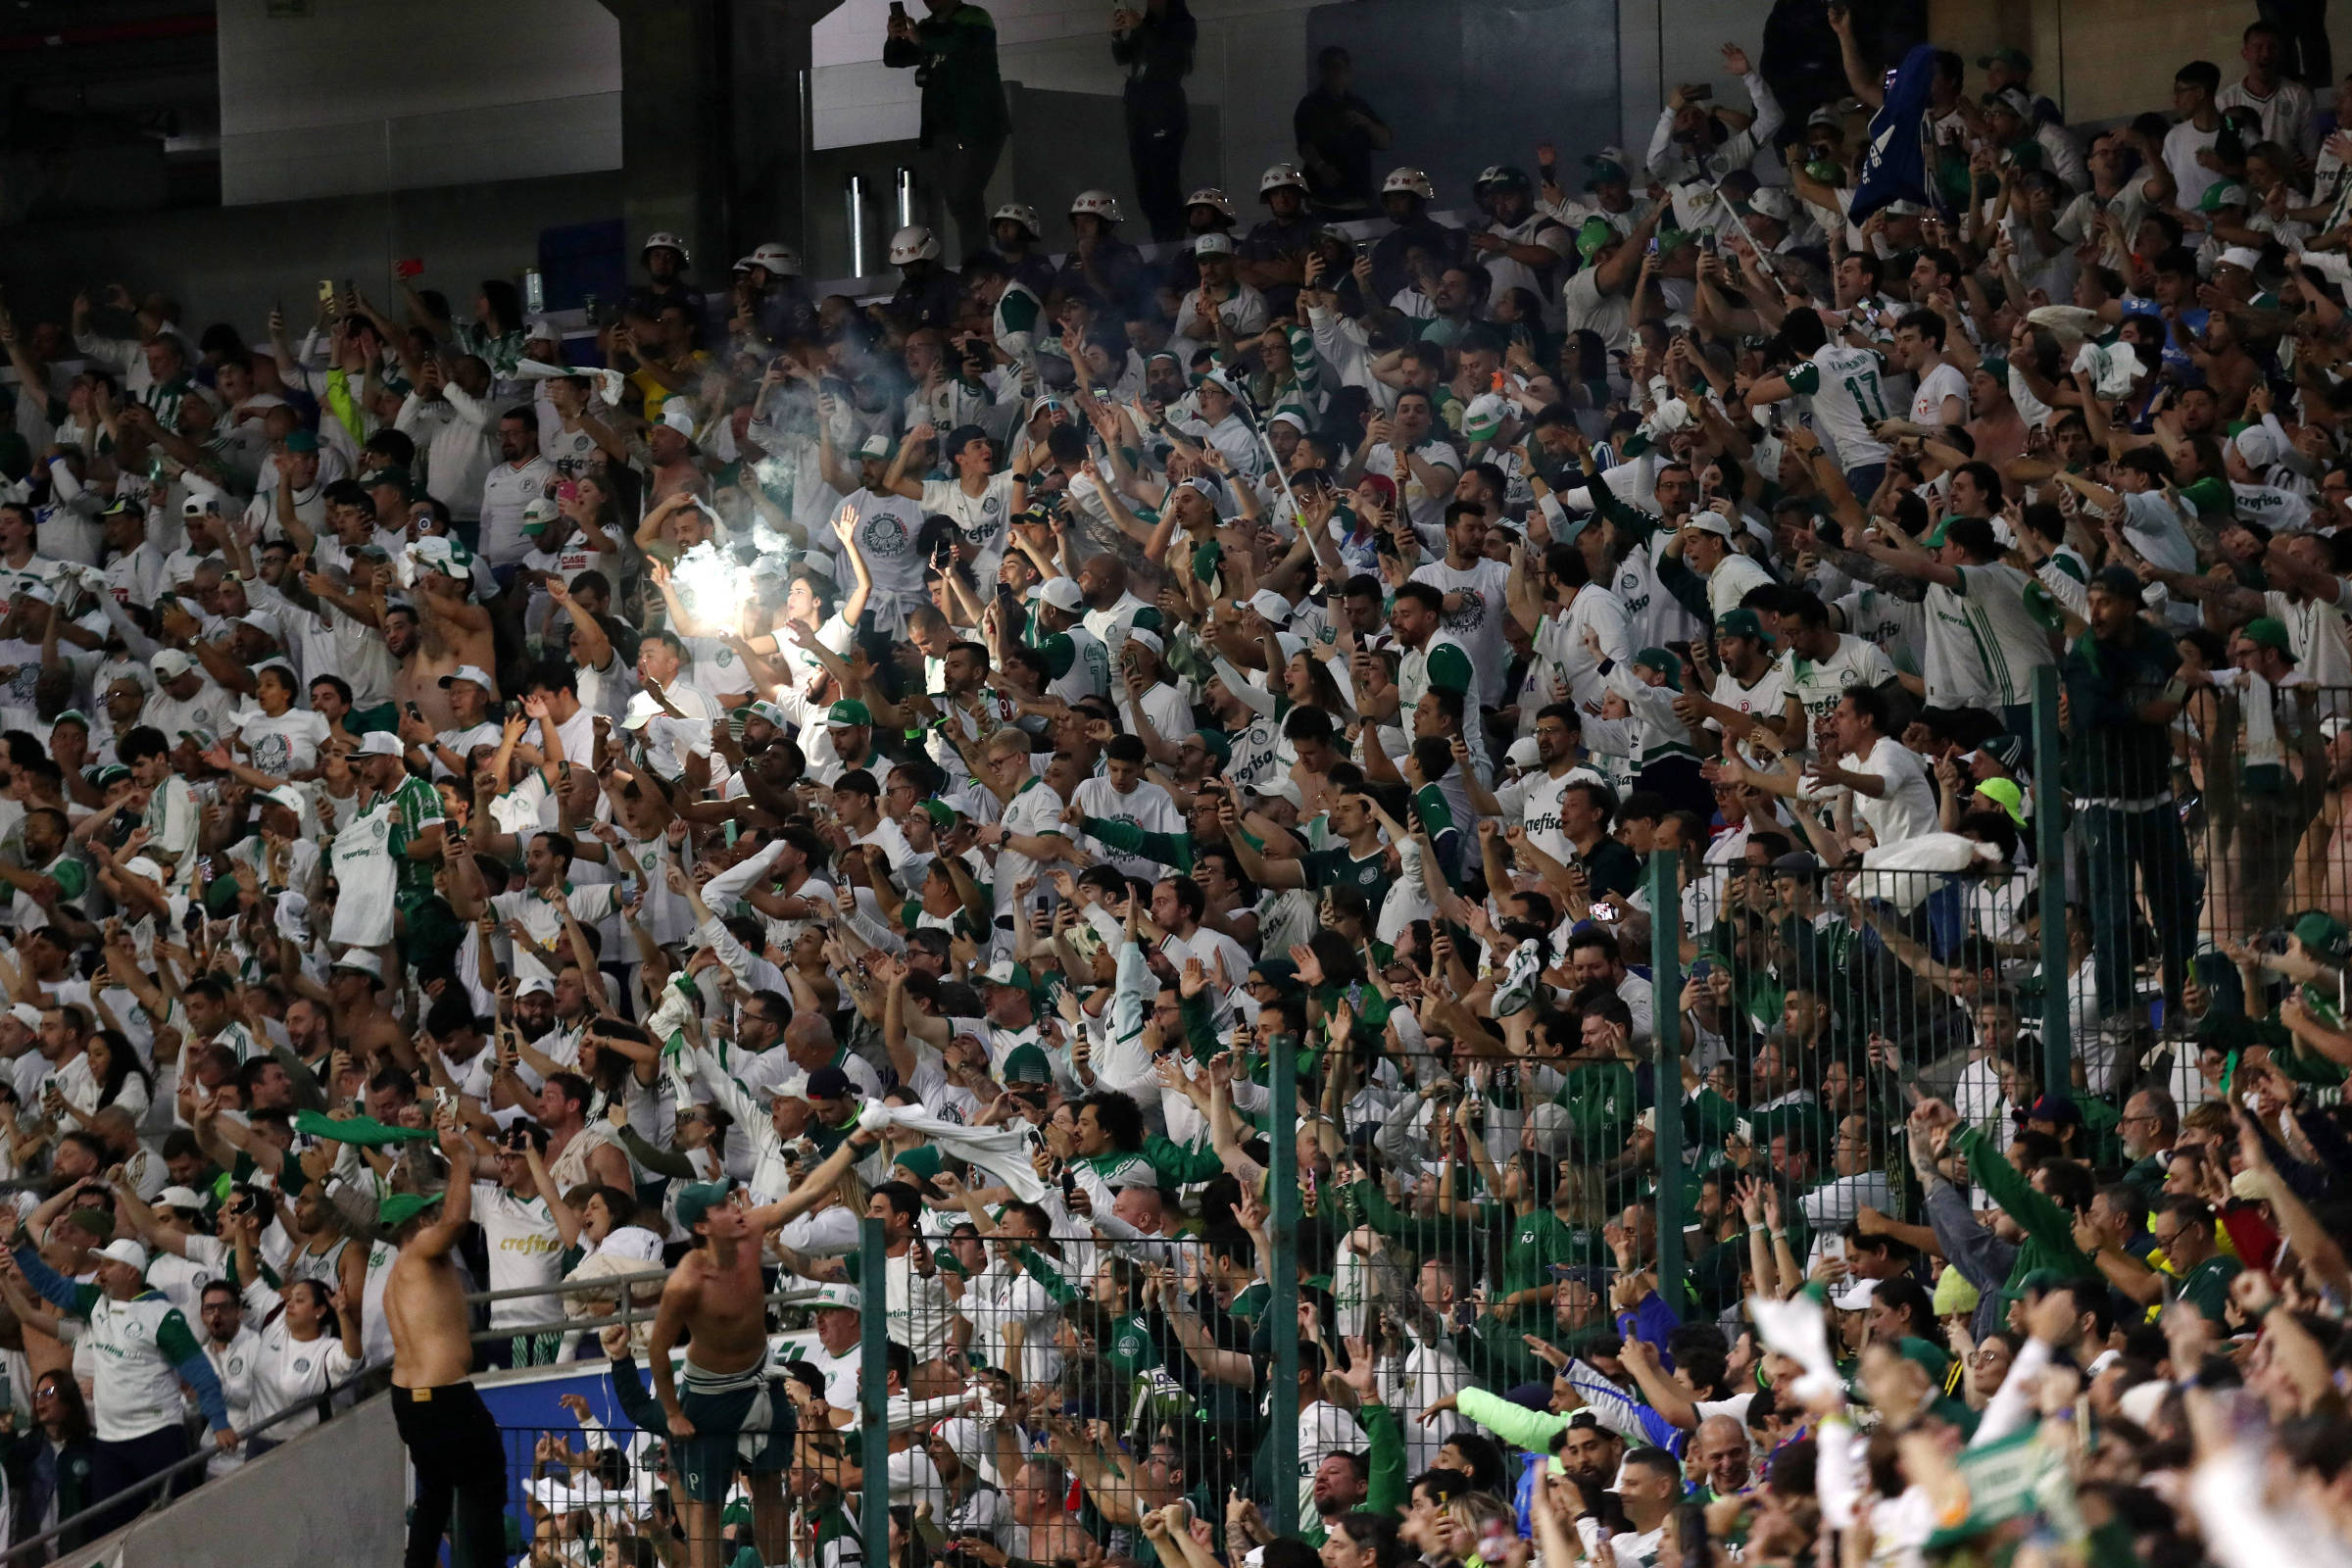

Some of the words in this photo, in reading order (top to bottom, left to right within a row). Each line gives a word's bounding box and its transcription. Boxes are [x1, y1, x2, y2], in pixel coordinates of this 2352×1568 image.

[1844, 370, 1887, 420] 17
[2236, 493, 2282, 511] crefisa
[562, 555, 587, 564] CASE
[1229, 750, 1273, 783] refisa
[500, 1234, 560, 1255] crefisa
[689, 1473, 699, 1491] P
